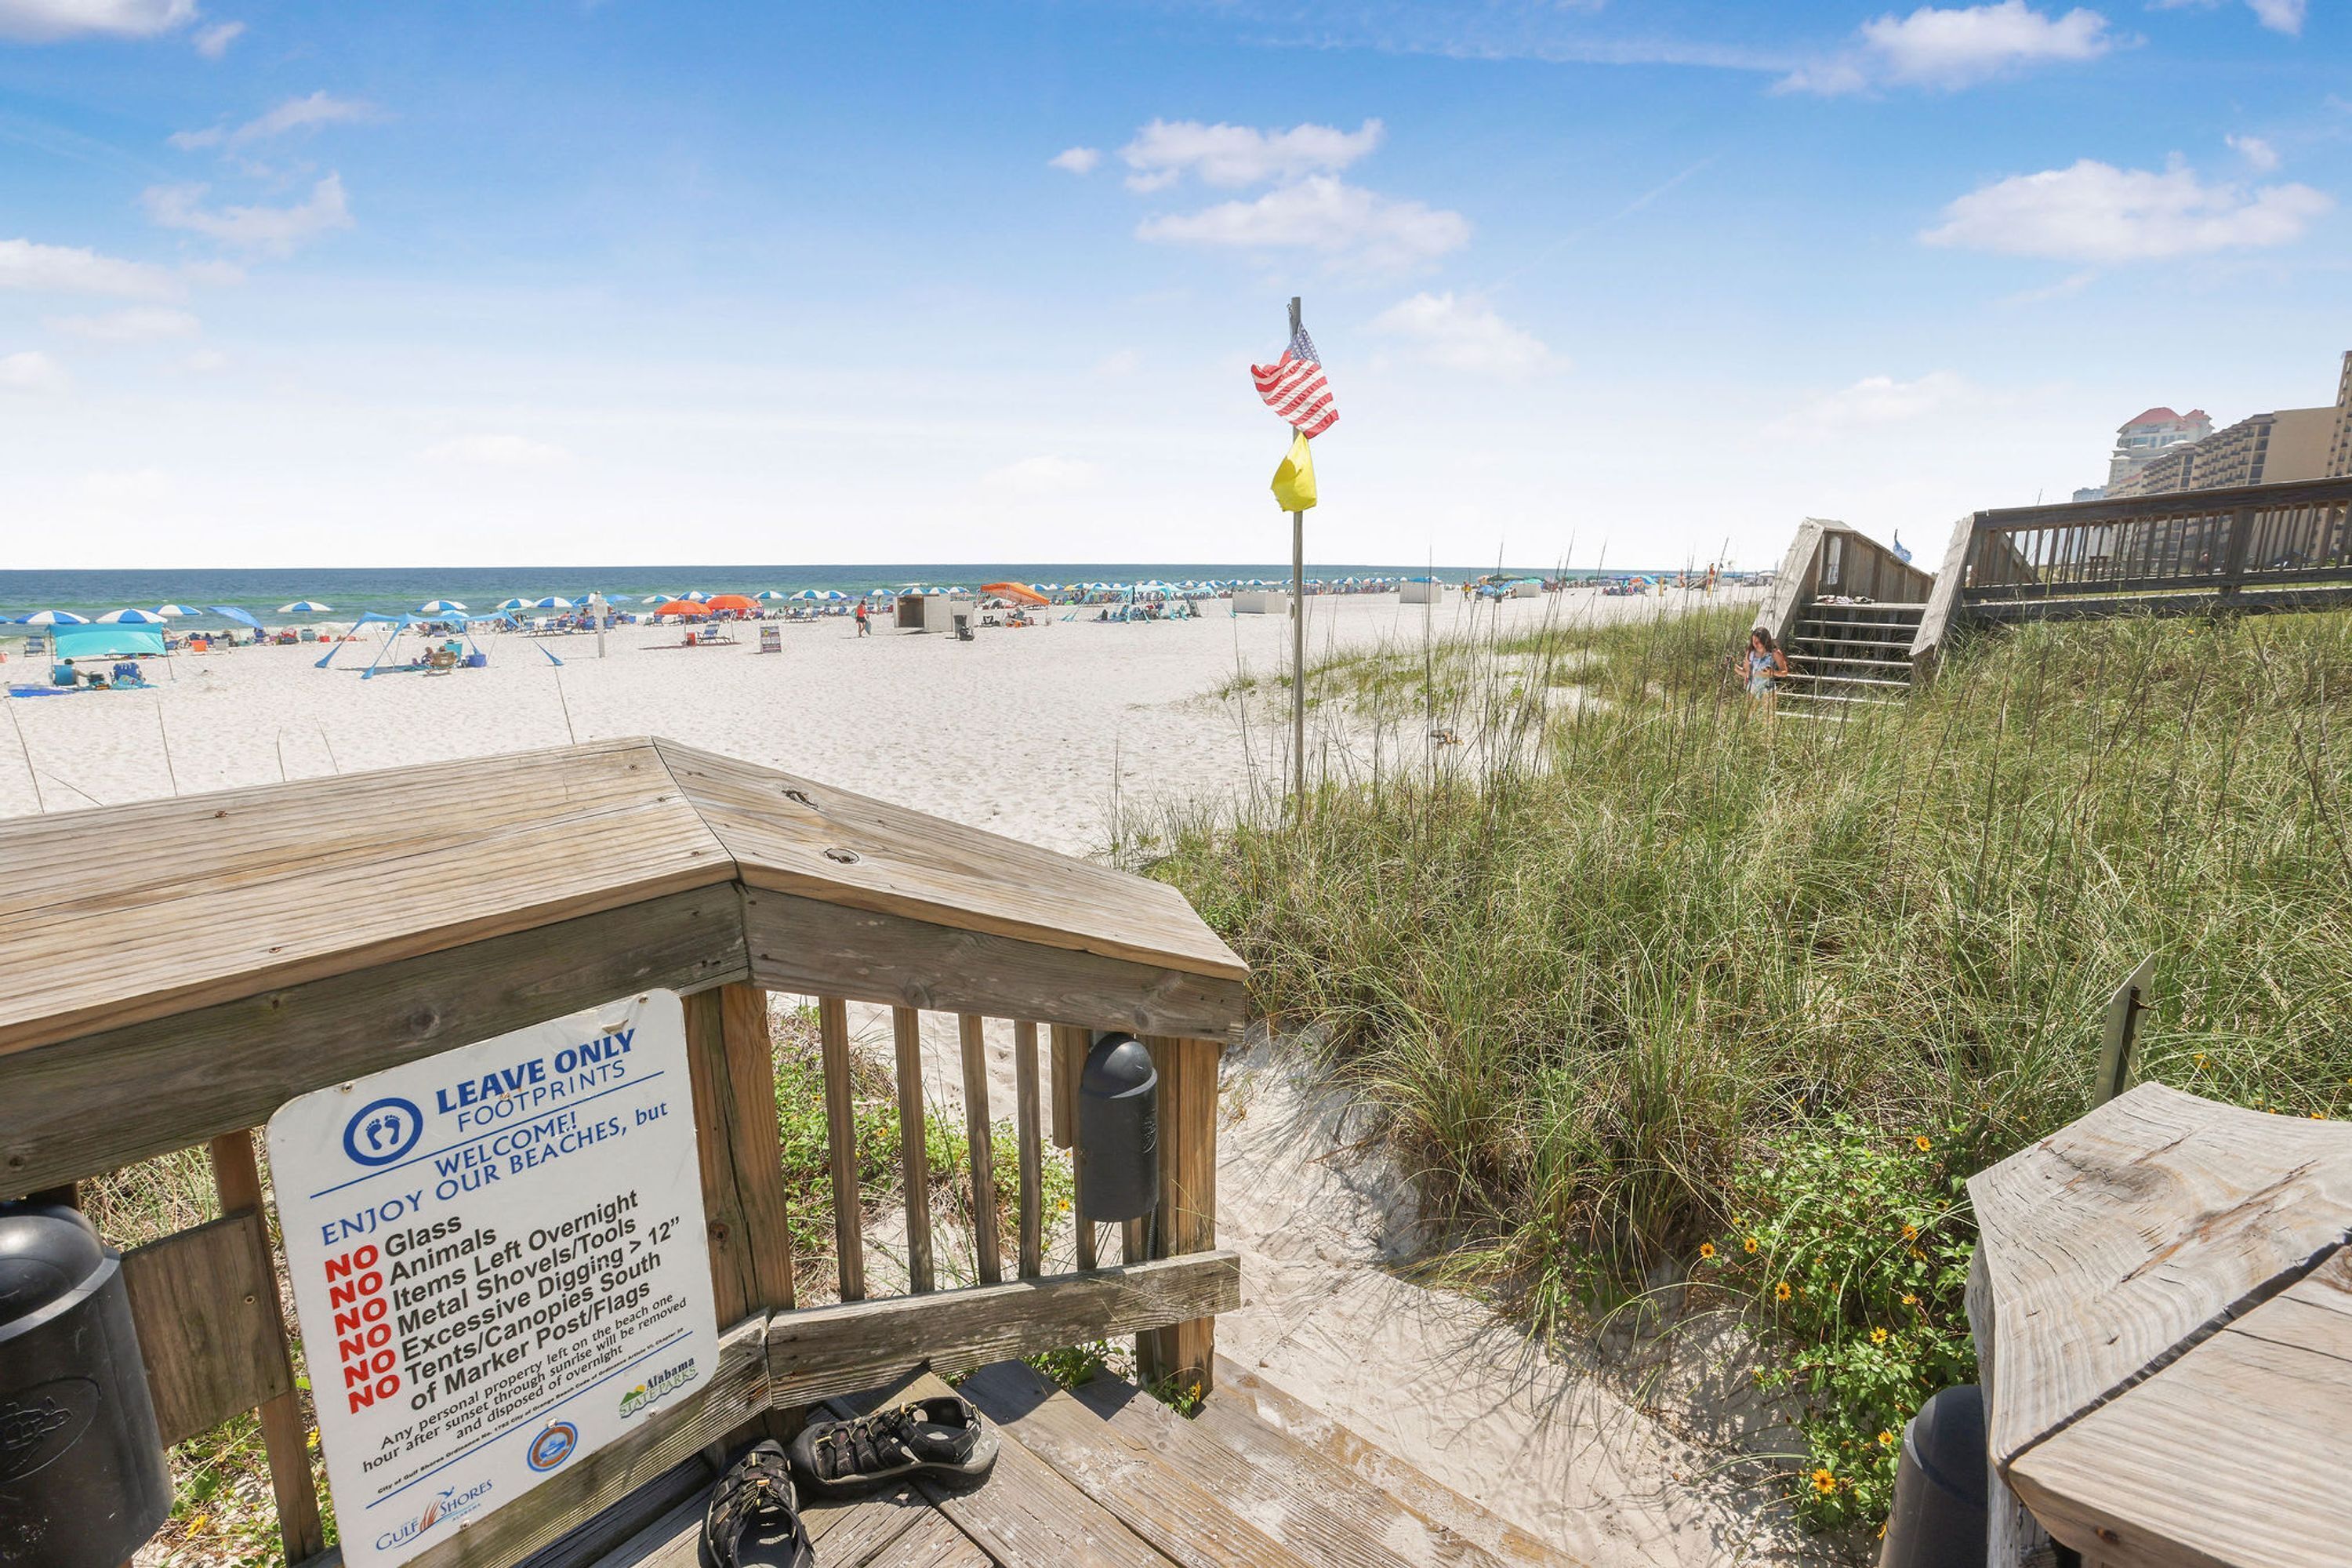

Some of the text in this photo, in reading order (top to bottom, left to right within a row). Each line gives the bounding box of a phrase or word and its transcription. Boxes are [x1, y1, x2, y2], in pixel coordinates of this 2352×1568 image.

[436, 1029, 635, 1114] LEAVE ONLY
[458, 1060, 625, 1132] FOOTPRINTS
[321, 1102, 668, 1246] ENJOY OUR BEACHES, but
[434, 1111, 576, 1178] WELCOME!
[325, 1216, 462, 1283] NO Glass
[329, 1229, 496, 1310] NO Animals
[334, 1189, 638, 1336] NO Items Left Overnight
[339, 1217, 636, 1363] NO Metal Shovels/Tools
[343, 1349, 396, 1388] NO
[401, 1291, 531, 1362] Excessive
[538, 1247, 623, 1298] Digging
[348, 1251, 661, 1414] NO Tents/Canopies South
[380, 1294, 673, 1450] Any personal property left on the beach one
[411, 1283, 650, 1411] of Marker Post/Flags
[647, 1357, 695, 1391] Alabama
[363, 1297, 687, 1472] hour after sunset through sunrise will be removed
[378, 1483, 392, 1494] City
[404, 1469, 418, 1480] Gulf
[420, 1457, 444, 1472] Shores
[445, 1438, 480, 1457] Ordinance
[511, 1414, 524, 1423] City
[532, 1398, 554, 1411] Orange
[556, 1387, 574, 1399] Beach
[575, 1378, 590, 1388] Code
[456, 1345, 623, 1439] and disposed of overnight
[619, 1366, 696, 1417] STATE PARKS
